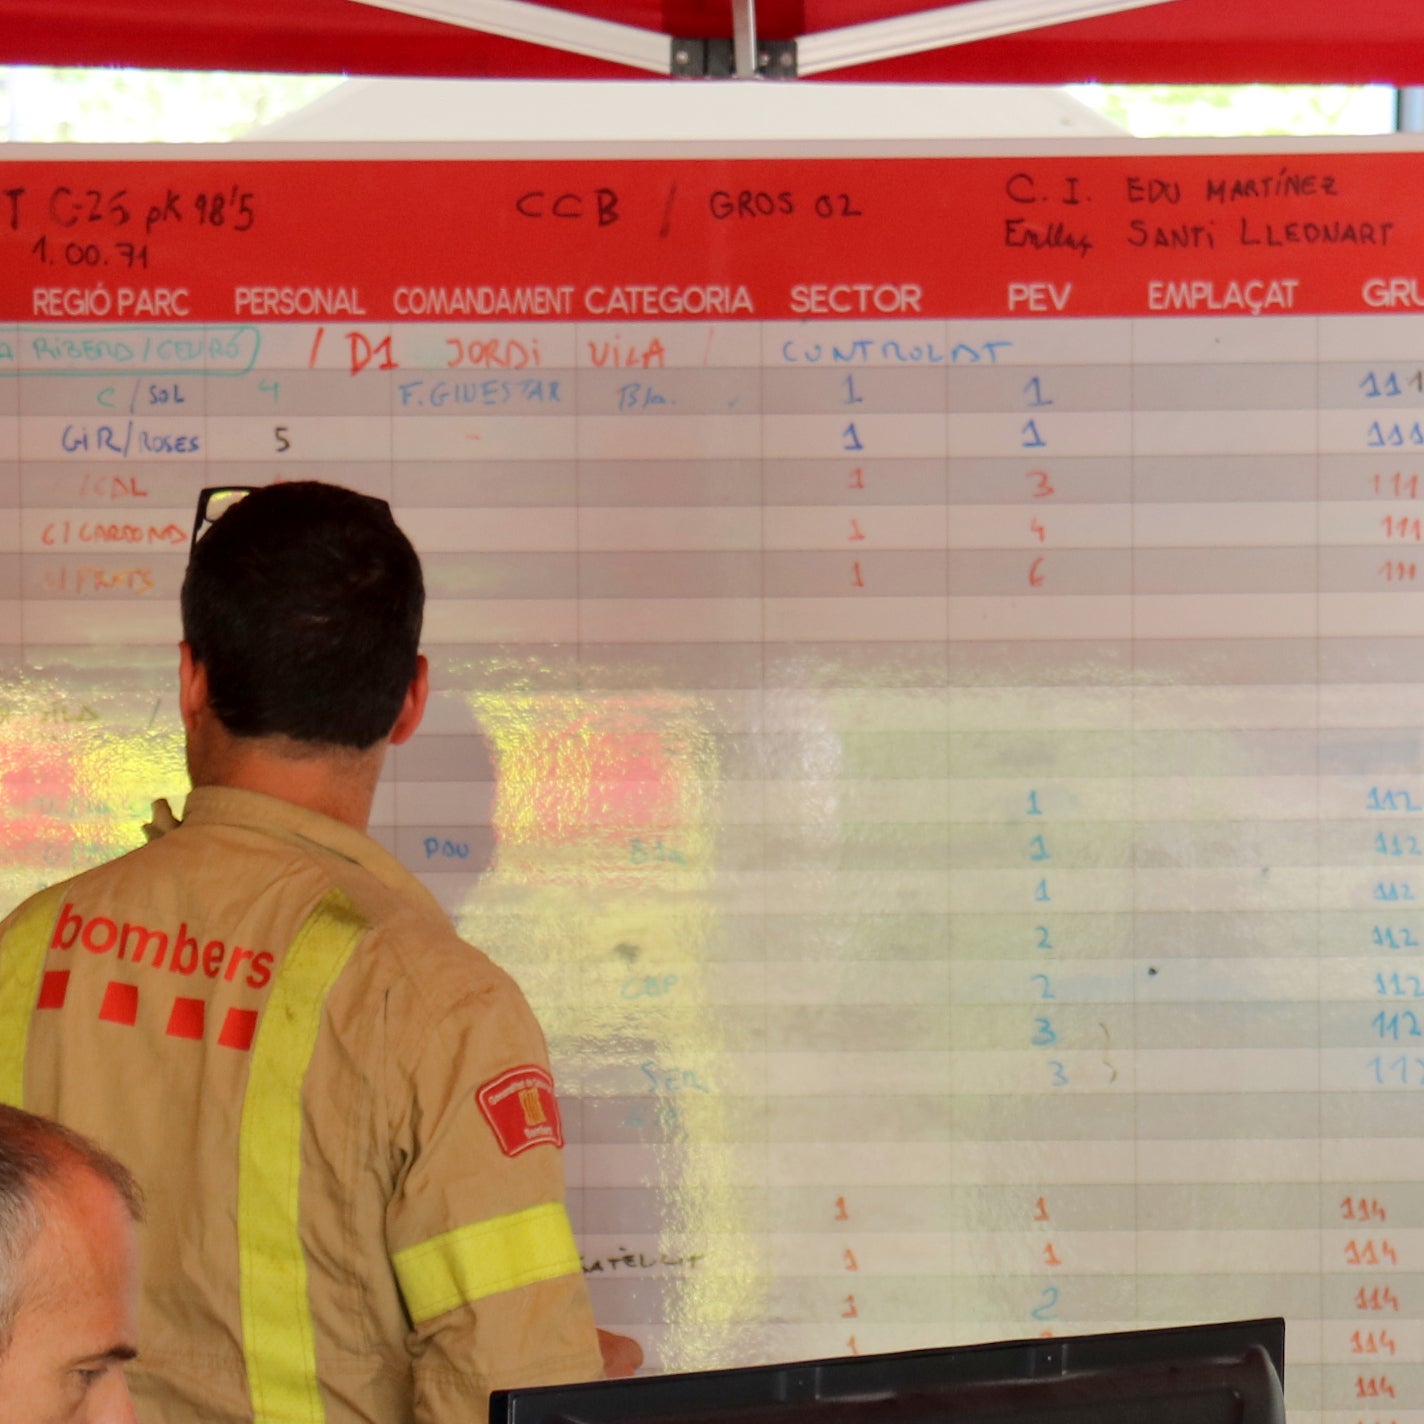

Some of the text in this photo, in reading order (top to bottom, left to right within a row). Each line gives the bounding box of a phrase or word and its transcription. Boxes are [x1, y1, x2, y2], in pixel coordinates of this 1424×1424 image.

[710, 190, 794, 220] GROS
[1127, 177, 1181, 205] EDU
[33, 282, 190, 316] REGIÓ PARC
[235, 286, 366, 316] PERSONAL
[393, 286, 575, 315] COMANDAMENT
[584, 285, 754, 314] CATEGORIA
[791, 284, 922, 314] SECTOR
[1008, 282, 1072, 312] PEV
[1148, 279, 1300, 315] EMPLAÇAT
[1023, 376, 1054, 407] 1
[275, 427, 290, 452] 5
[843, 422, 865, 451] 1
[1022, 419, 1048, 448] 1
[50, 903, 274, 989] bombers
